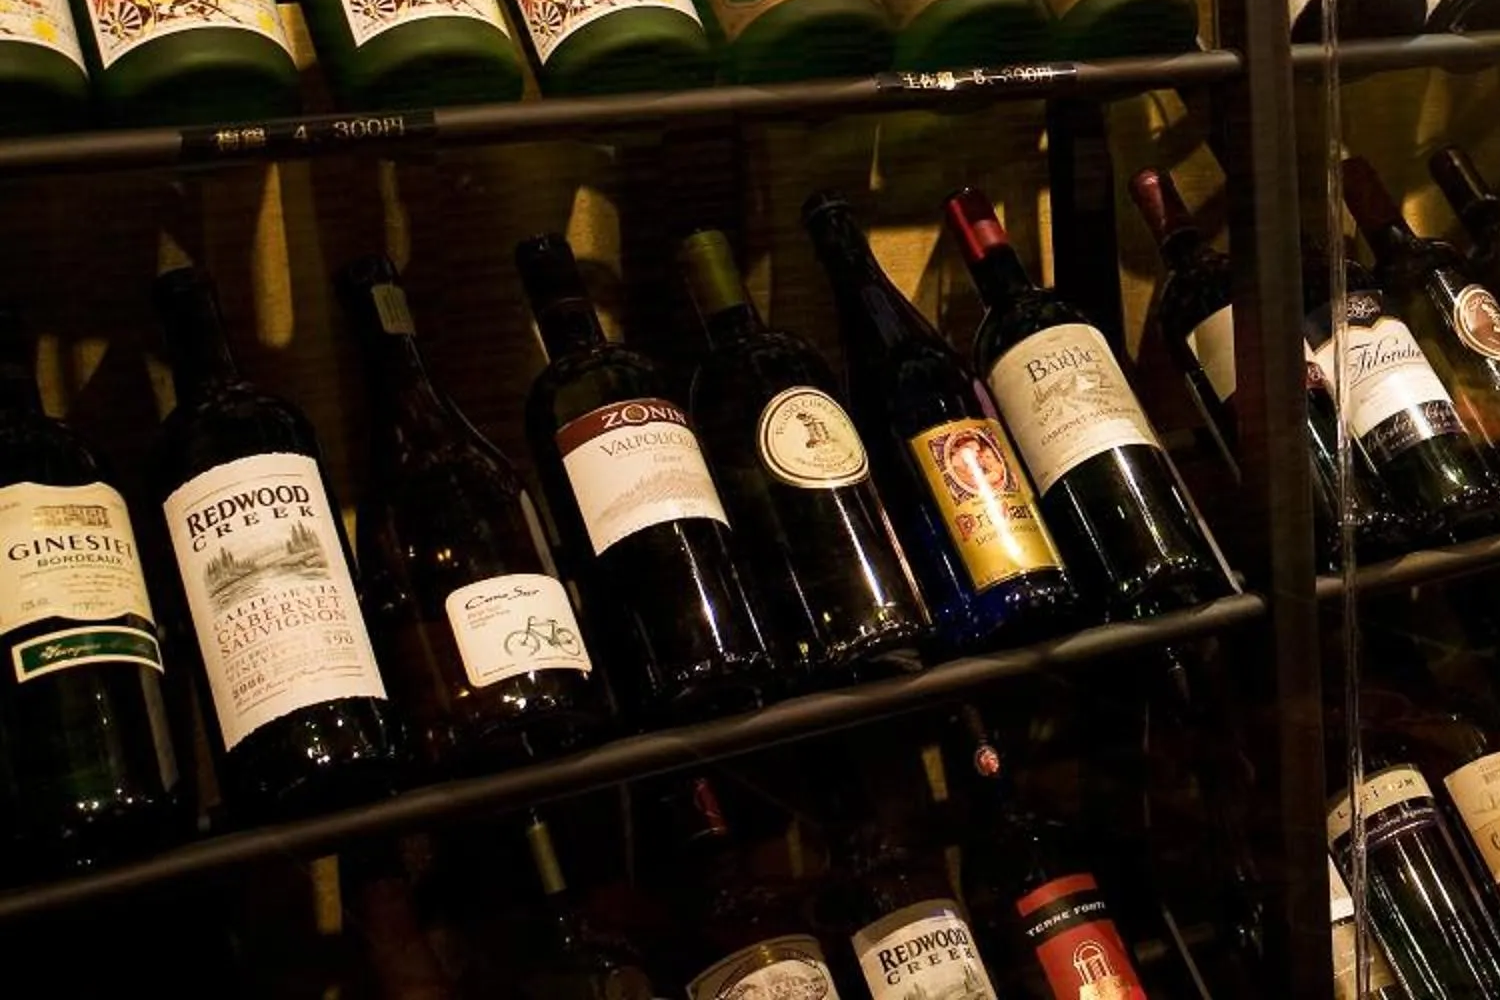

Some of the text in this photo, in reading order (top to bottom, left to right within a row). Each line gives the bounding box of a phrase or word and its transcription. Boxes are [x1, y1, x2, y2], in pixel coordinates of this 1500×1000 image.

[601, 403, 687, 429] ZONIN
[186, 485, 310, 538] REDWOOD
[192, 505, 316, 553] CREEK
[37, 552, 123, 568] BORDEAUX
[217, 596, 342, 646] CABERNET
[221, 609, 347, 659] SAUVIGNON
[877, 926, 969, 973] REDWOOD
[886, 948, 975, 985] CREEK
